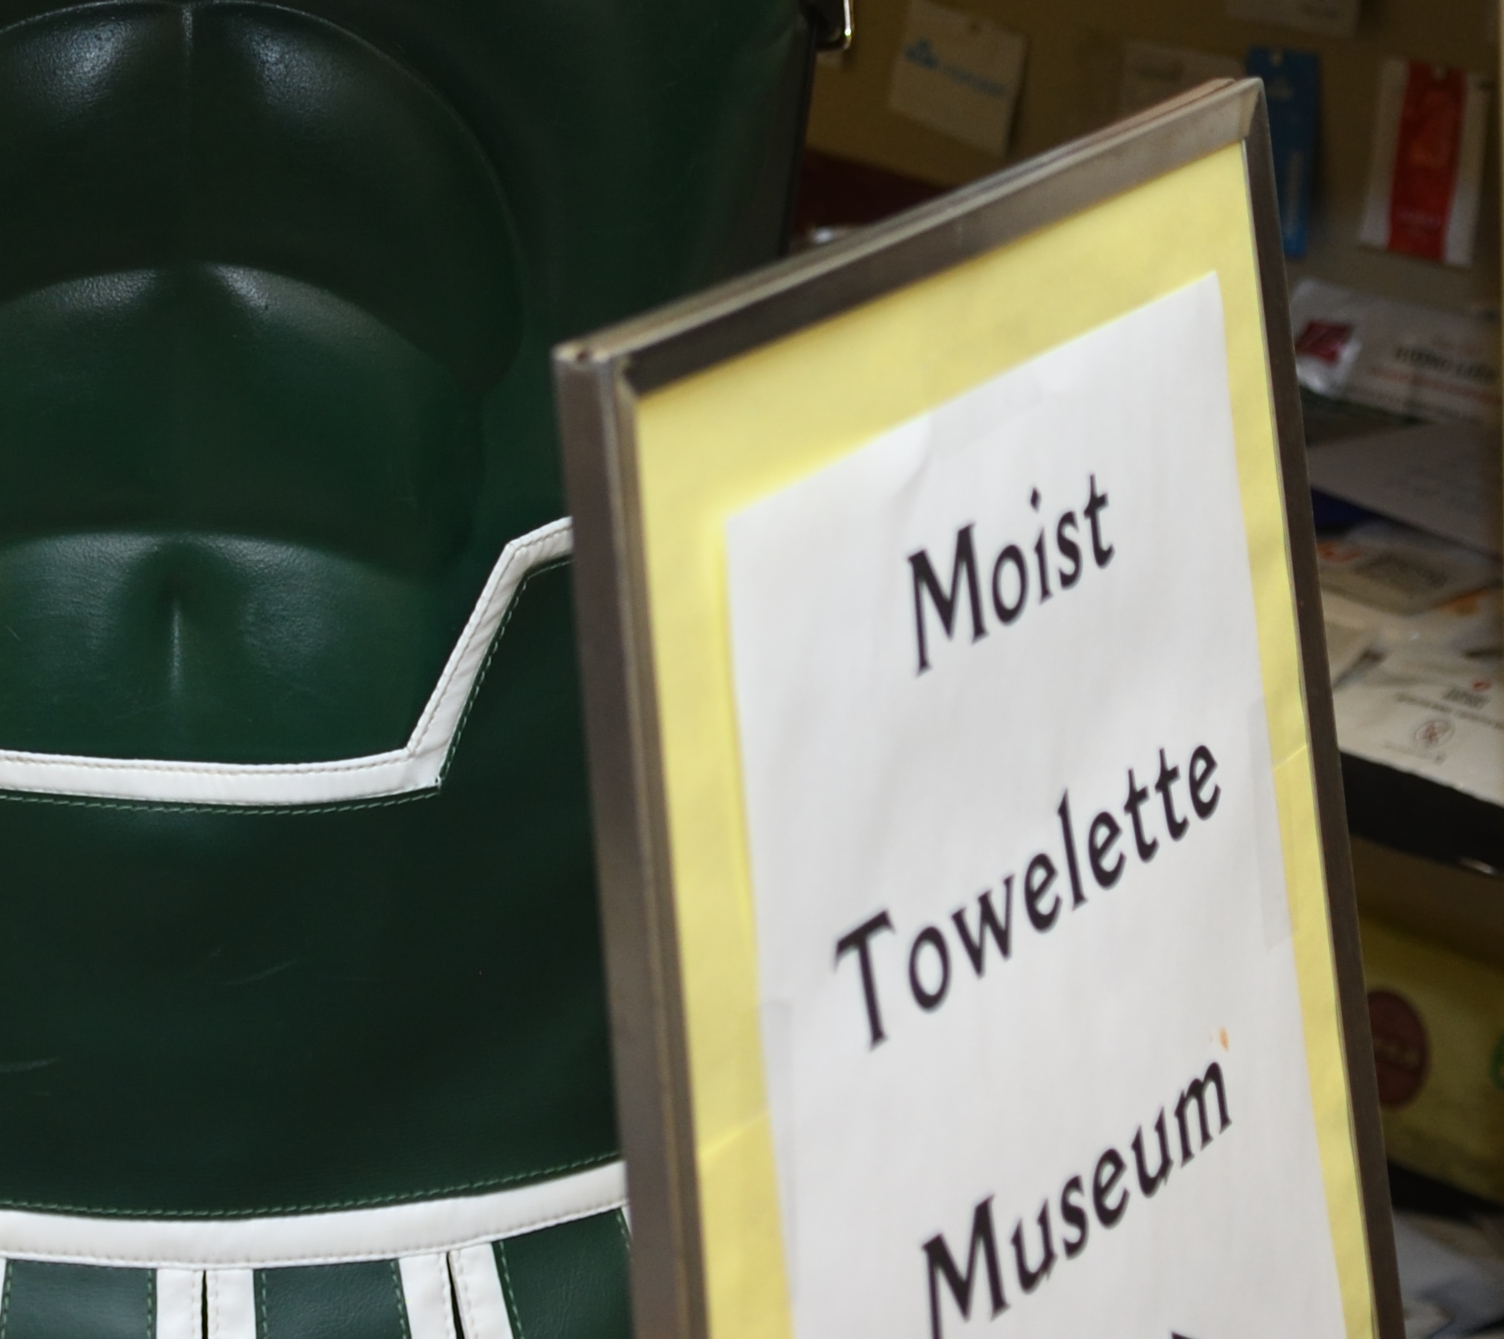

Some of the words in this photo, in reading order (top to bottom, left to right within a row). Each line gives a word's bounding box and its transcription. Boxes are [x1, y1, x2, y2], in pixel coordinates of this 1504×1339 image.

[907, 473, 1116, 678] Moist
[832, 743, 1223, 1053] Towelette
[921, 1059, 1234, 1339] Museum
